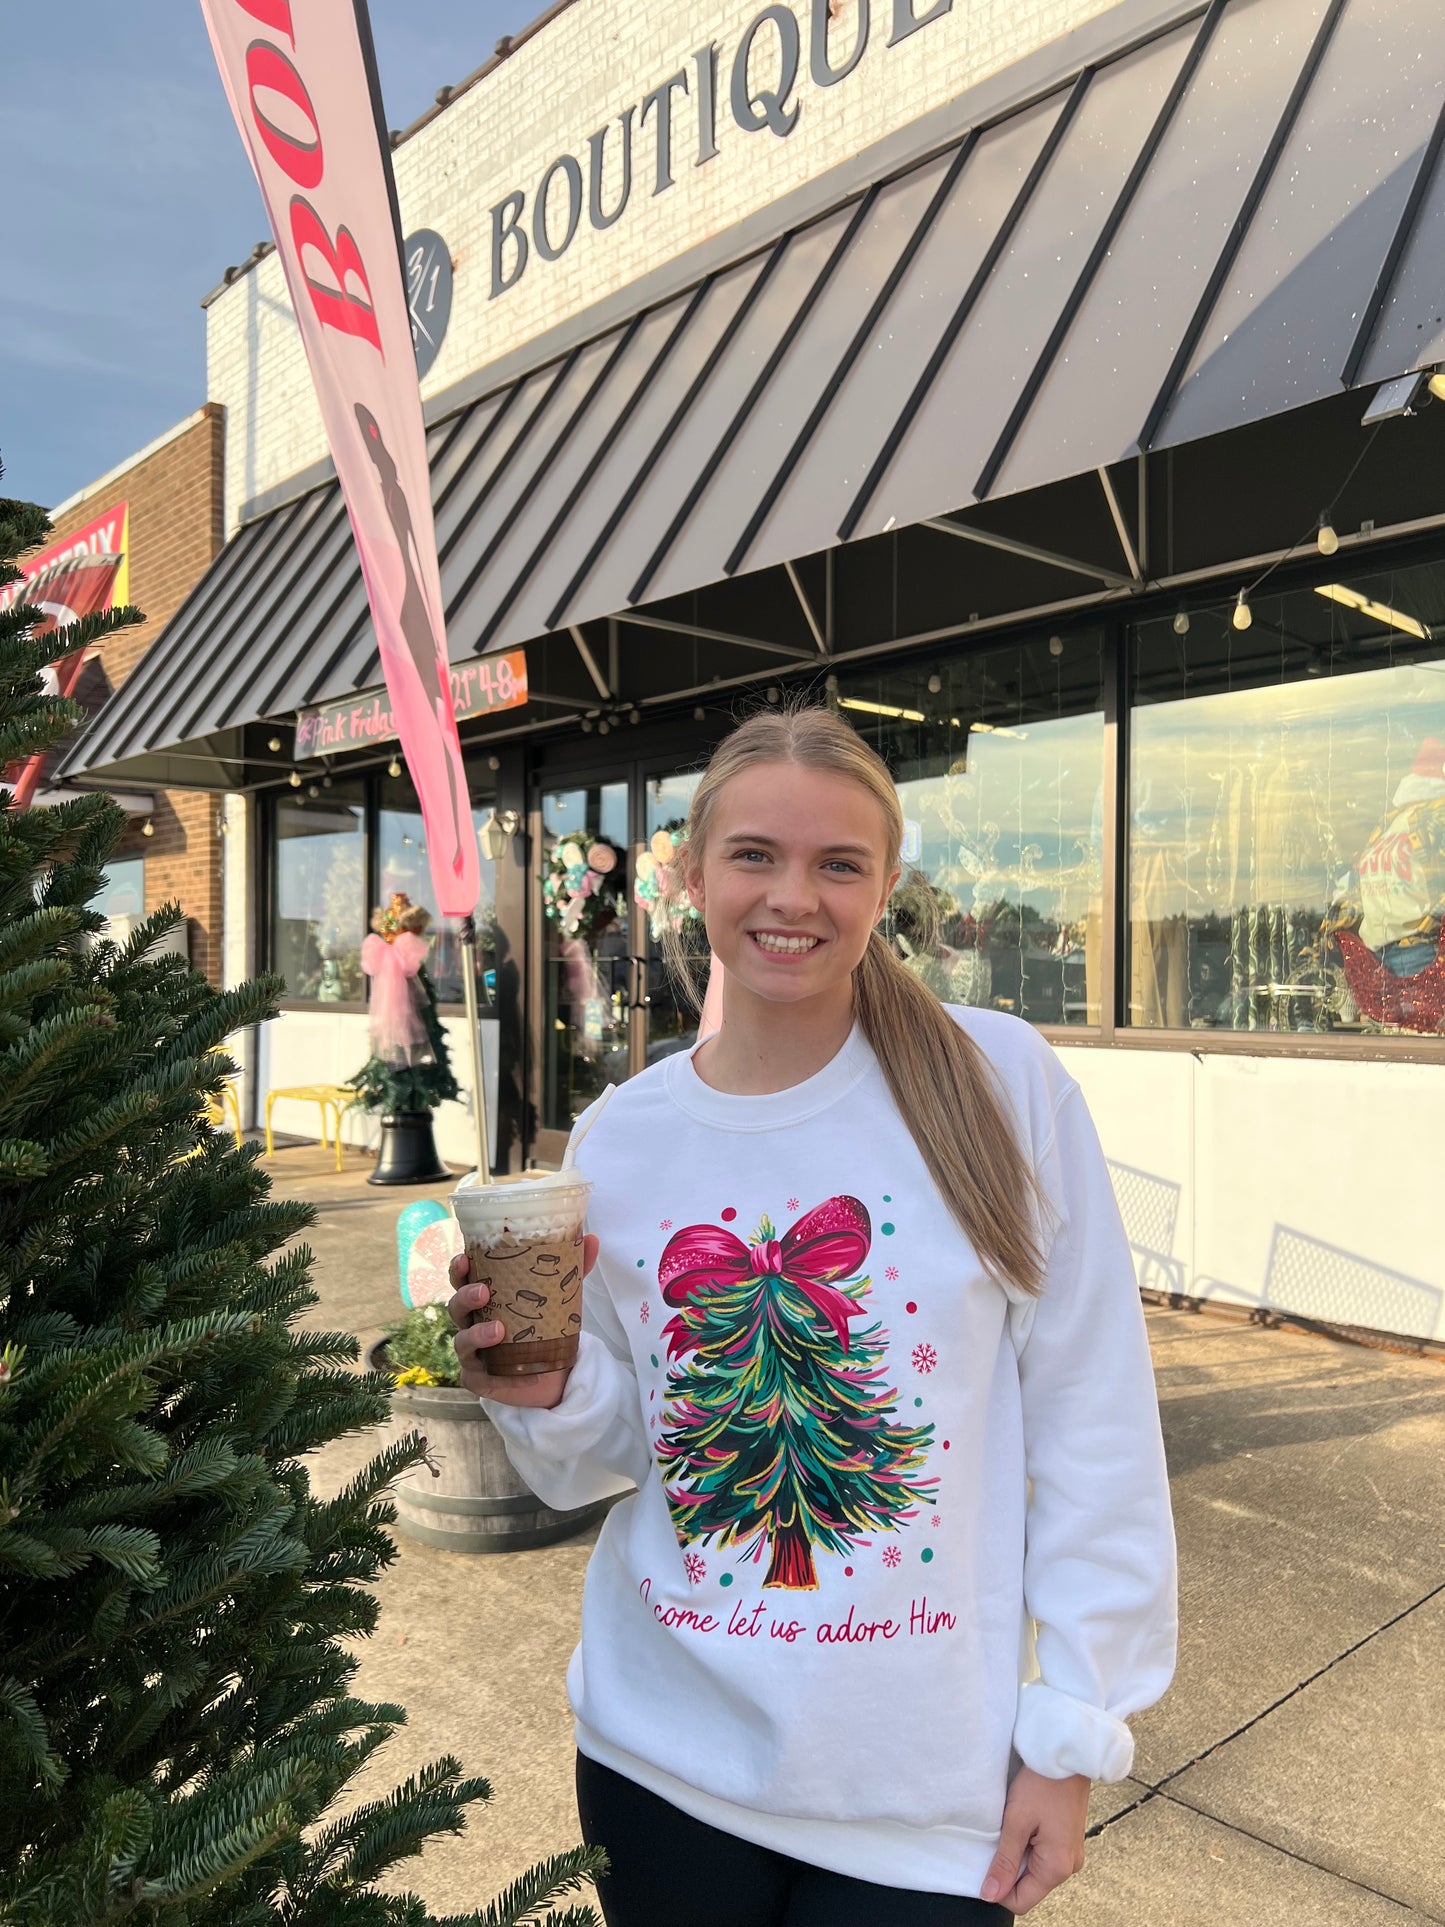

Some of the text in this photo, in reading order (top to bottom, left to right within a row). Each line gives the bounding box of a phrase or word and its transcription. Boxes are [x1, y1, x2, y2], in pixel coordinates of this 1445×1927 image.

[654, 1604, 720, 1633] come
[727, 1599, 767, 1637] let
[770, 1619, 807, 1643] us
[816, 1604, 901, 1643] adore
[909, 1596, 957, 1636] Him
